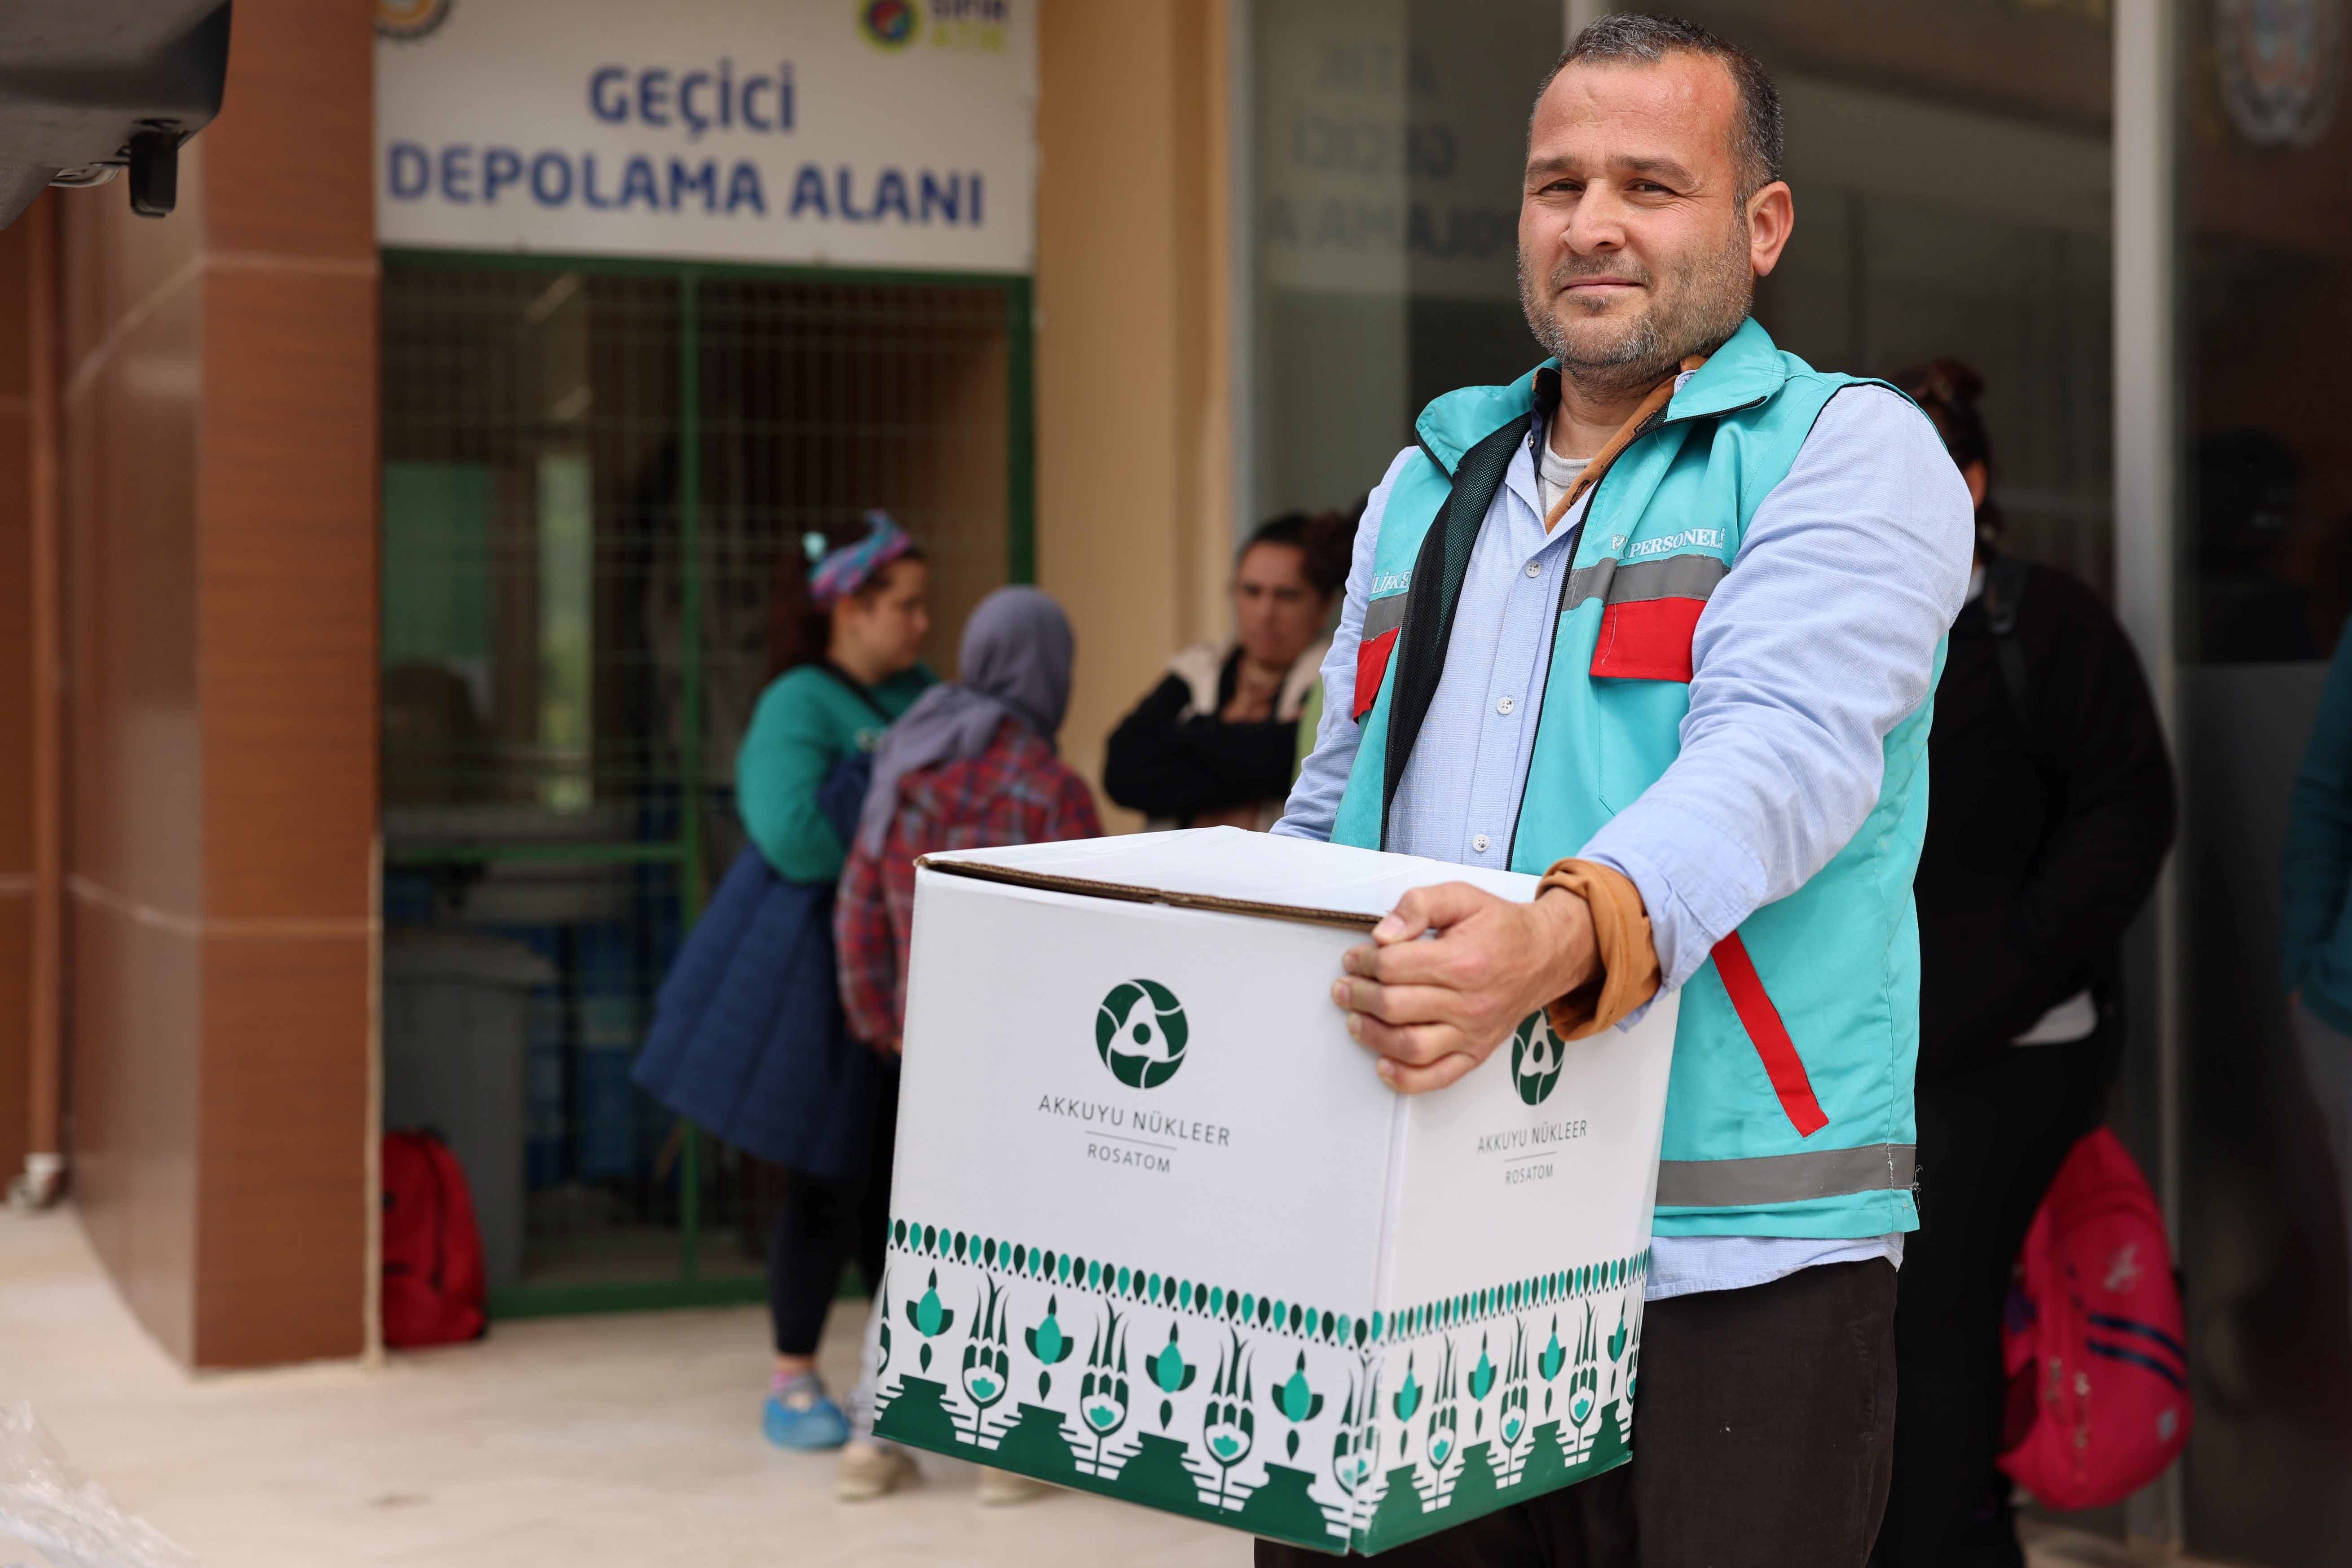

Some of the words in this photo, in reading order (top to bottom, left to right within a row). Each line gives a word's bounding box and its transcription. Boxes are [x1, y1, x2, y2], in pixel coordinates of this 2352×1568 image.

[589, 60, 796, 139] GEÇİCİ
[388, 144, 767, 217] DEPOLAMA
[789, 163, 982, 225] ALANI
[1627, 527, 1725, 559] PERSONELİ
[1038, 1094, 1123, 1126] AKKUYU
[1132, 1111, 1230, 1147] NÜKLEER
[1477, 1129, 1528, 1153] AKKUYU
[1531, 1120, 1587, 1144] NÜKLEER
[1087, 1143, 1170, 1173] ROSATOM
[1505, 1164, 1554, 1185] ROSATOM
